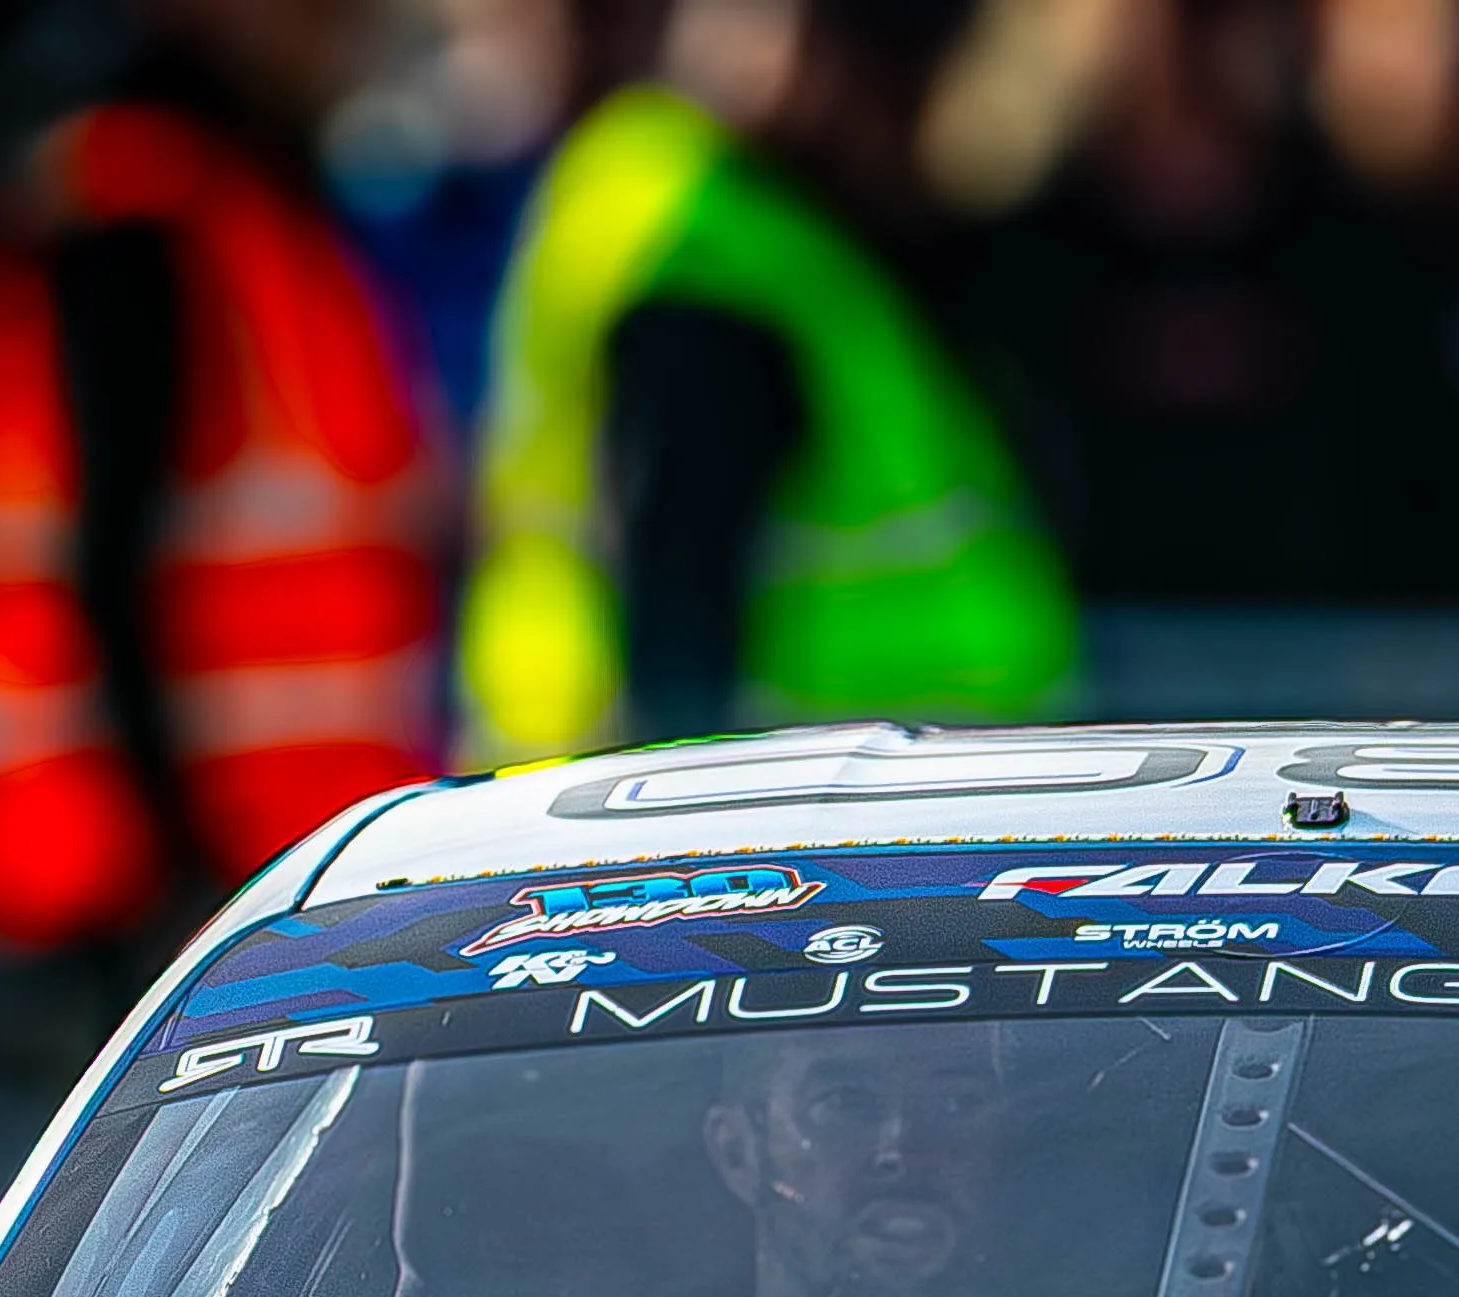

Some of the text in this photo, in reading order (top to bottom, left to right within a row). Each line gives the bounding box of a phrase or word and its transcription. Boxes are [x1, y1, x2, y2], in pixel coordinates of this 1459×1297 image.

[529, 868, 793, 917] 130
[486, 885, 810, 944] SHOWDOWN
[1074, 919, 1279, 941] STRÖM
[1123, 940, 1224, 949] WHEELS
